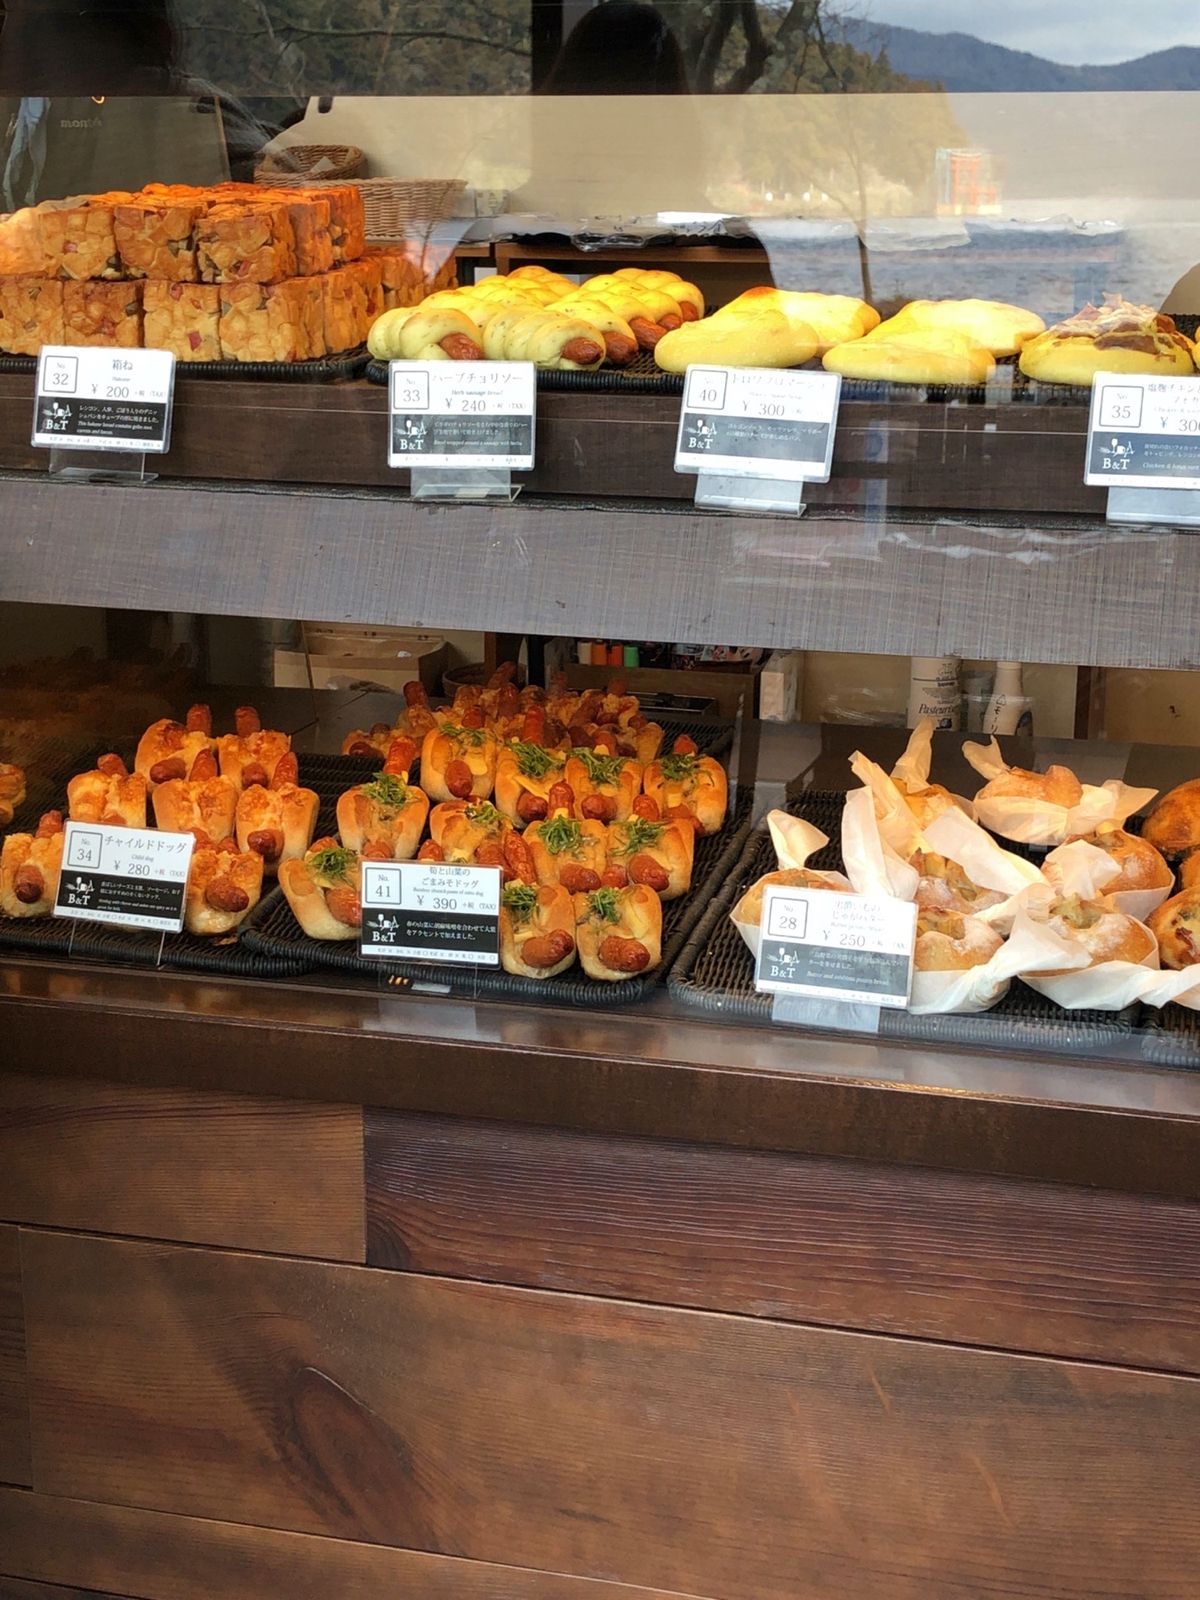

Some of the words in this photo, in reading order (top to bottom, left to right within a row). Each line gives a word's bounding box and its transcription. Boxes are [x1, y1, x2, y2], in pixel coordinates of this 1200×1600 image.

[52, 373, 69, 386] 32
[432, 372, 523, 384] ハーブチョリソー
[91, 383, 98, 394] ¥
[106, 386, 129, 399] 200
[402, 389, 421, 402] 33
[699, 389, 717, 402] 40
[445, 397, 453, 409] ¥
[461, 399, 486, 412] 240
[758, 403, 785, 417] 300
[1111, 405, 1131, 419] 35
[46, 420, 69, 431] B&T
[1160, 416, 1169, 428] ¥
[1179, 419, 1200, 432] 30
[400, 439, 424, 450] B&T
[689, 438, 713, 449] B&T
[1102, 458, 1130, 470] B&T
[104, 836, 187, 853] チャイルドドッグ
[77, 849, 92, 862] 34
[114, 860, 121, 871] ¥
[127, 863, 150, 876] 280
[422, 877, 480, 888] ごまみそドッグ
[375, 885, 391, 898] 41
[68, 894, 90, 905] B&T
[417, 895, 424, 906] ¥
[433, 898, 457, 910] 390
[778, 916, 797, 930] 28
[372, 932, 396, 942] B&T
[839, 933, 866, 947] 250
[770, 966, 795, 978] B&T
